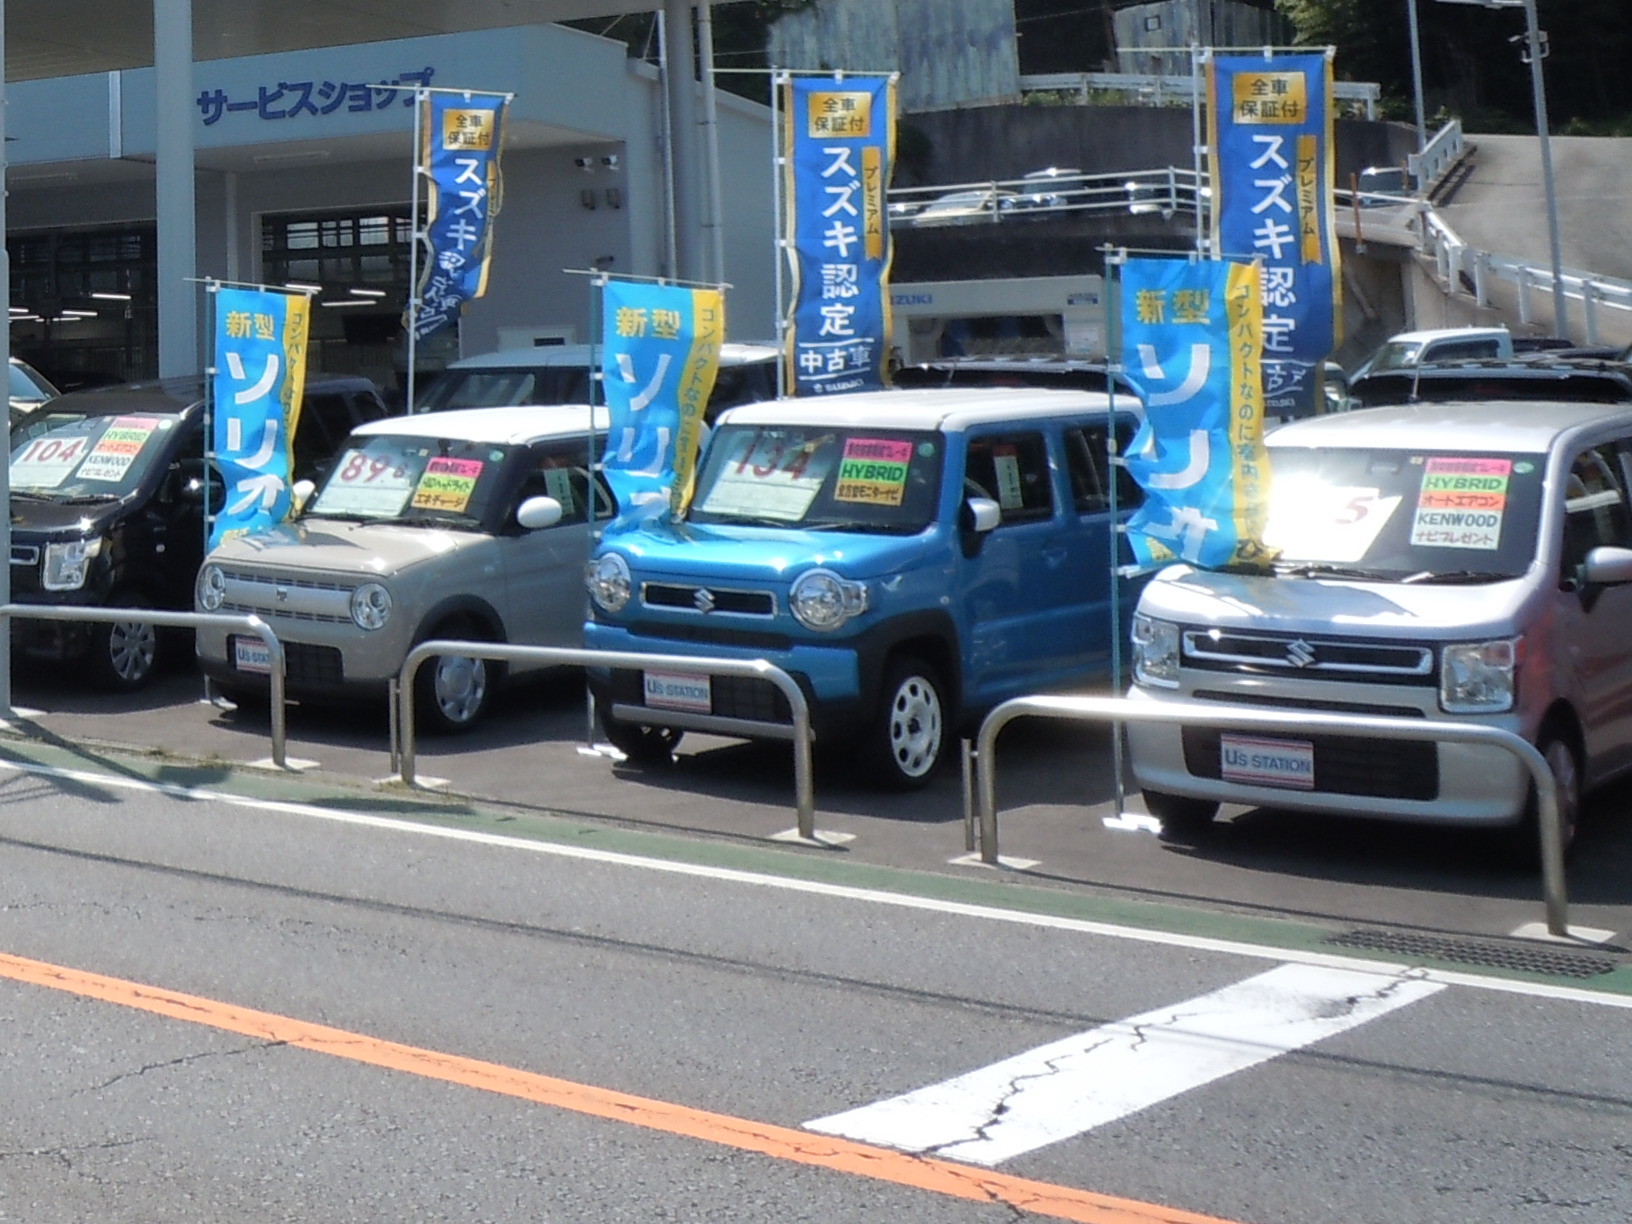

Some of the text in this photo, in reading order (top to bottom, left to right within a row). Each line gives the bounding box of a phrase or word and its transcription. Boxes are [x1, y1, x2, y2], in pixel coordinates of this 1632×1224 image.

[196, 66, 435, 126] サービスショップ
[1250, 79, 1289, 96] 全車
[822, 97, 856, 113] 全車
[1240, 100, 1299, 118] 保証付
[455, 114, 483, 128] 全車
[814, 116, 864, 133] 保証付
[448, 131, 490, 146] 保証付
[864, 166, 879, 236] プレミアム
[1298, 157, 1314, 236] プレミアム
[819, 147, 860, 337] スズキ認定
[1136, 288, 1210, 325] 新型
[225, 310, 275, 340] 新型
[615, 306, 681, 340] 新型
[799, 345, 871, 374] 中古車
[105, 430, 147, 441] HYBRID
[225, 351, 285, 516] ソリオ
[23, 440, 84, 462] 104
[88, 454, 130, 466] KENWOOD
[842, 464, 904, 482] HYBRID
[1425, 477, 1502, 490] HYBRID
[1423, 494, 1500, 507] オートエアコン
[1417, 512, 1498, 527] KENWOOD
[1415, 531, 1494, 545] ナビプレゼント
[1251, 754, 1311, 772] STATION
